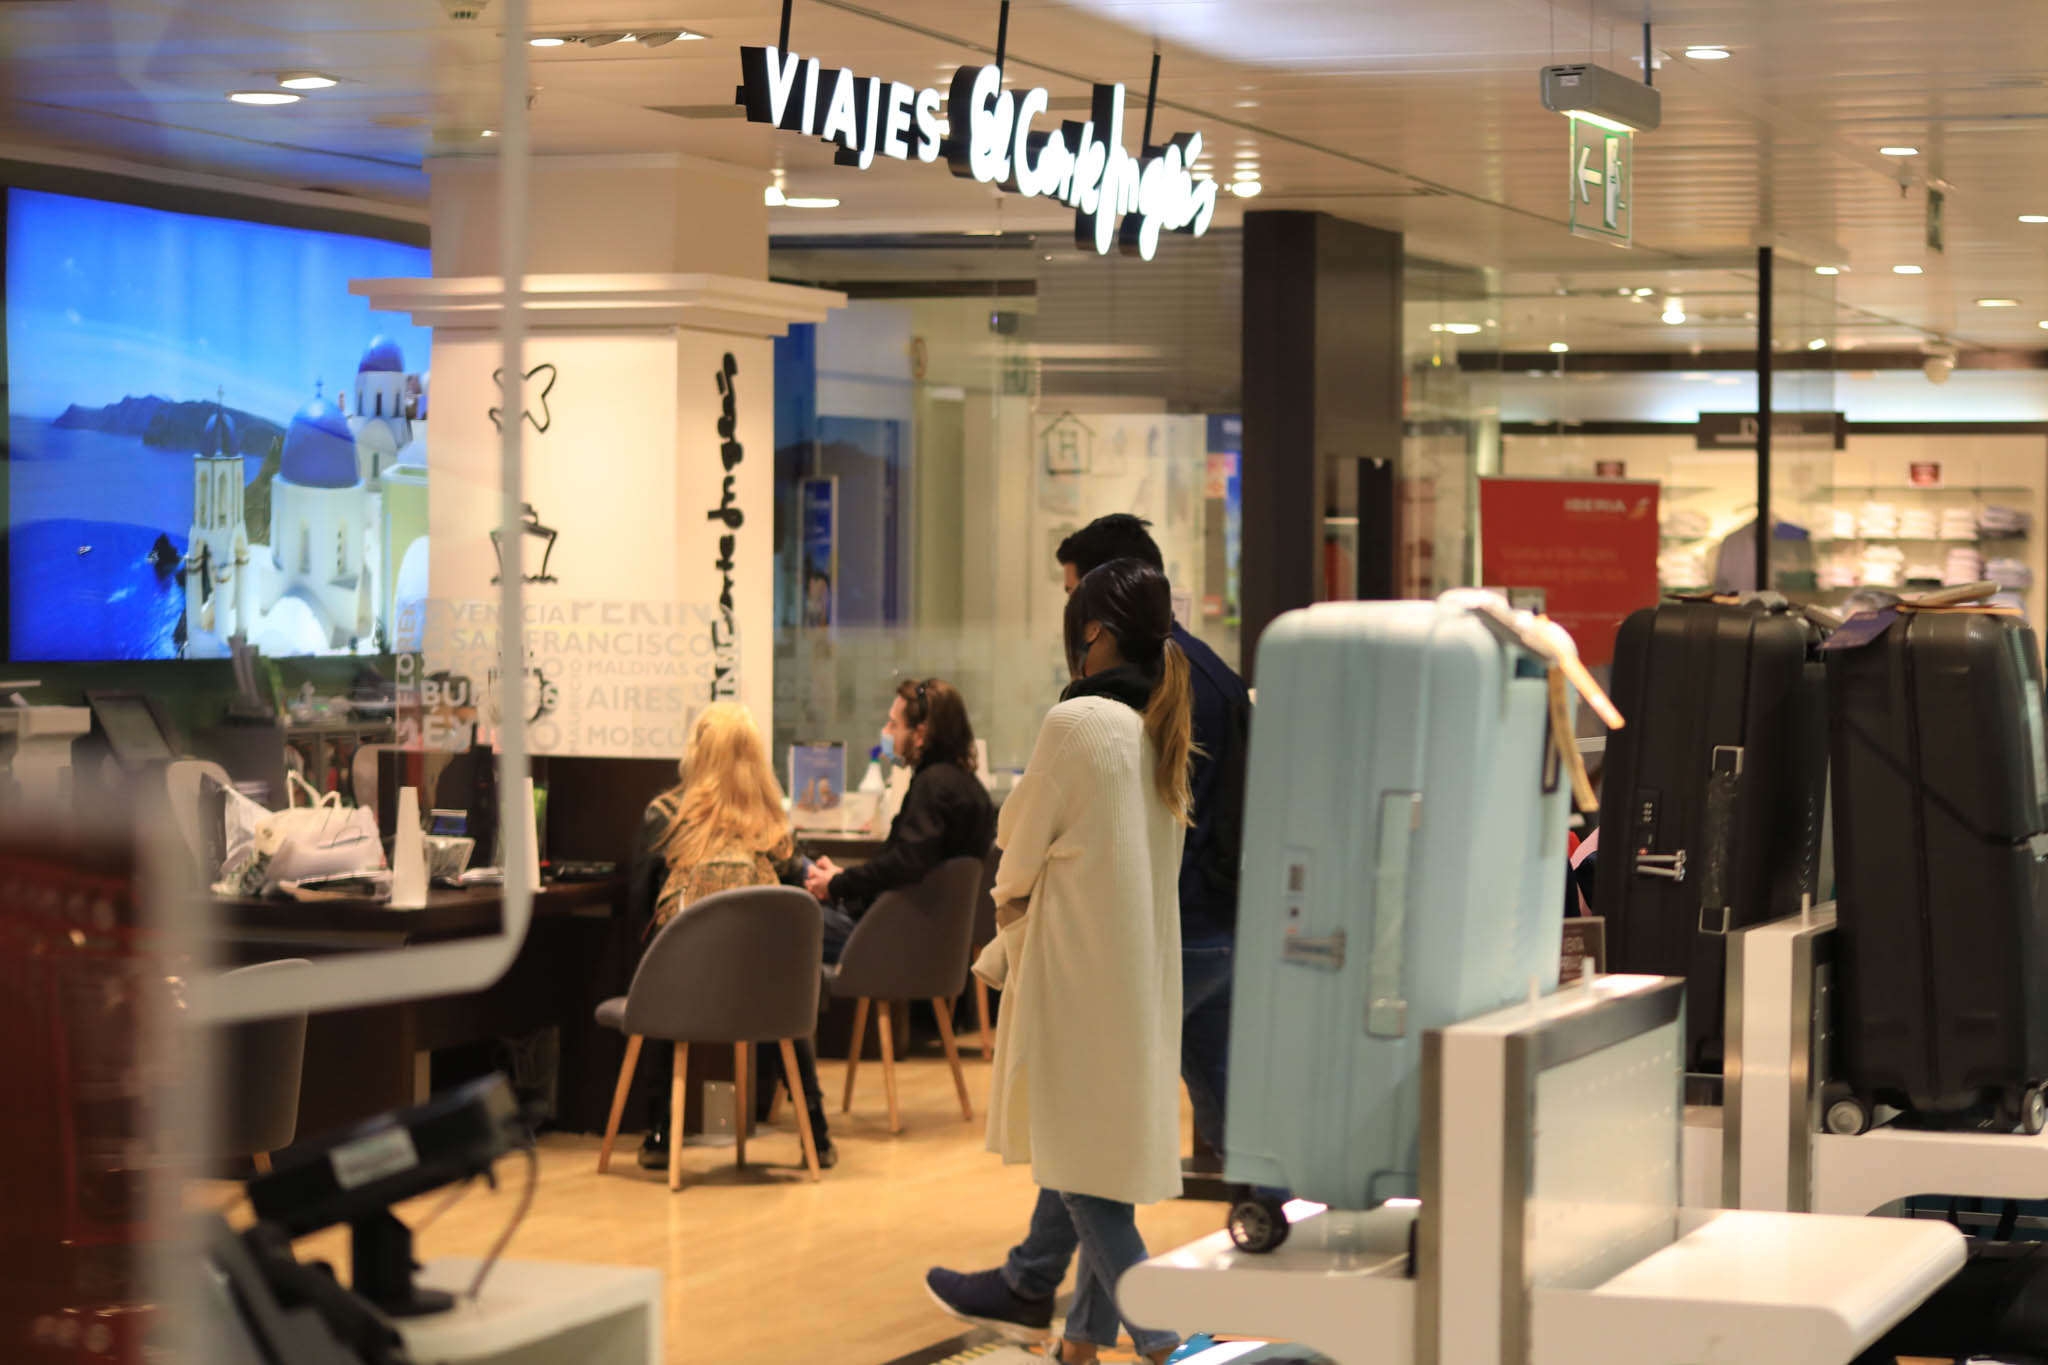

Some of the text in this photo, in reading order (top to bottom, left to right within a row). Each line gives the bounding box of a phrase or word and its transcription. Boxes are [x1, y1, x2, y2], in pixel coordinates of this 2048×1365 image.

[765, 45, 943, 170] VIAJES
[970, 64, 1015, 183] El
[450, 603, 562, 624] VENCIA
[525, 631, 713, 657] FRANCISCO
[587, 659, 688, 674] MALDIVAS
[585, 686, 682, 712] AIRES
